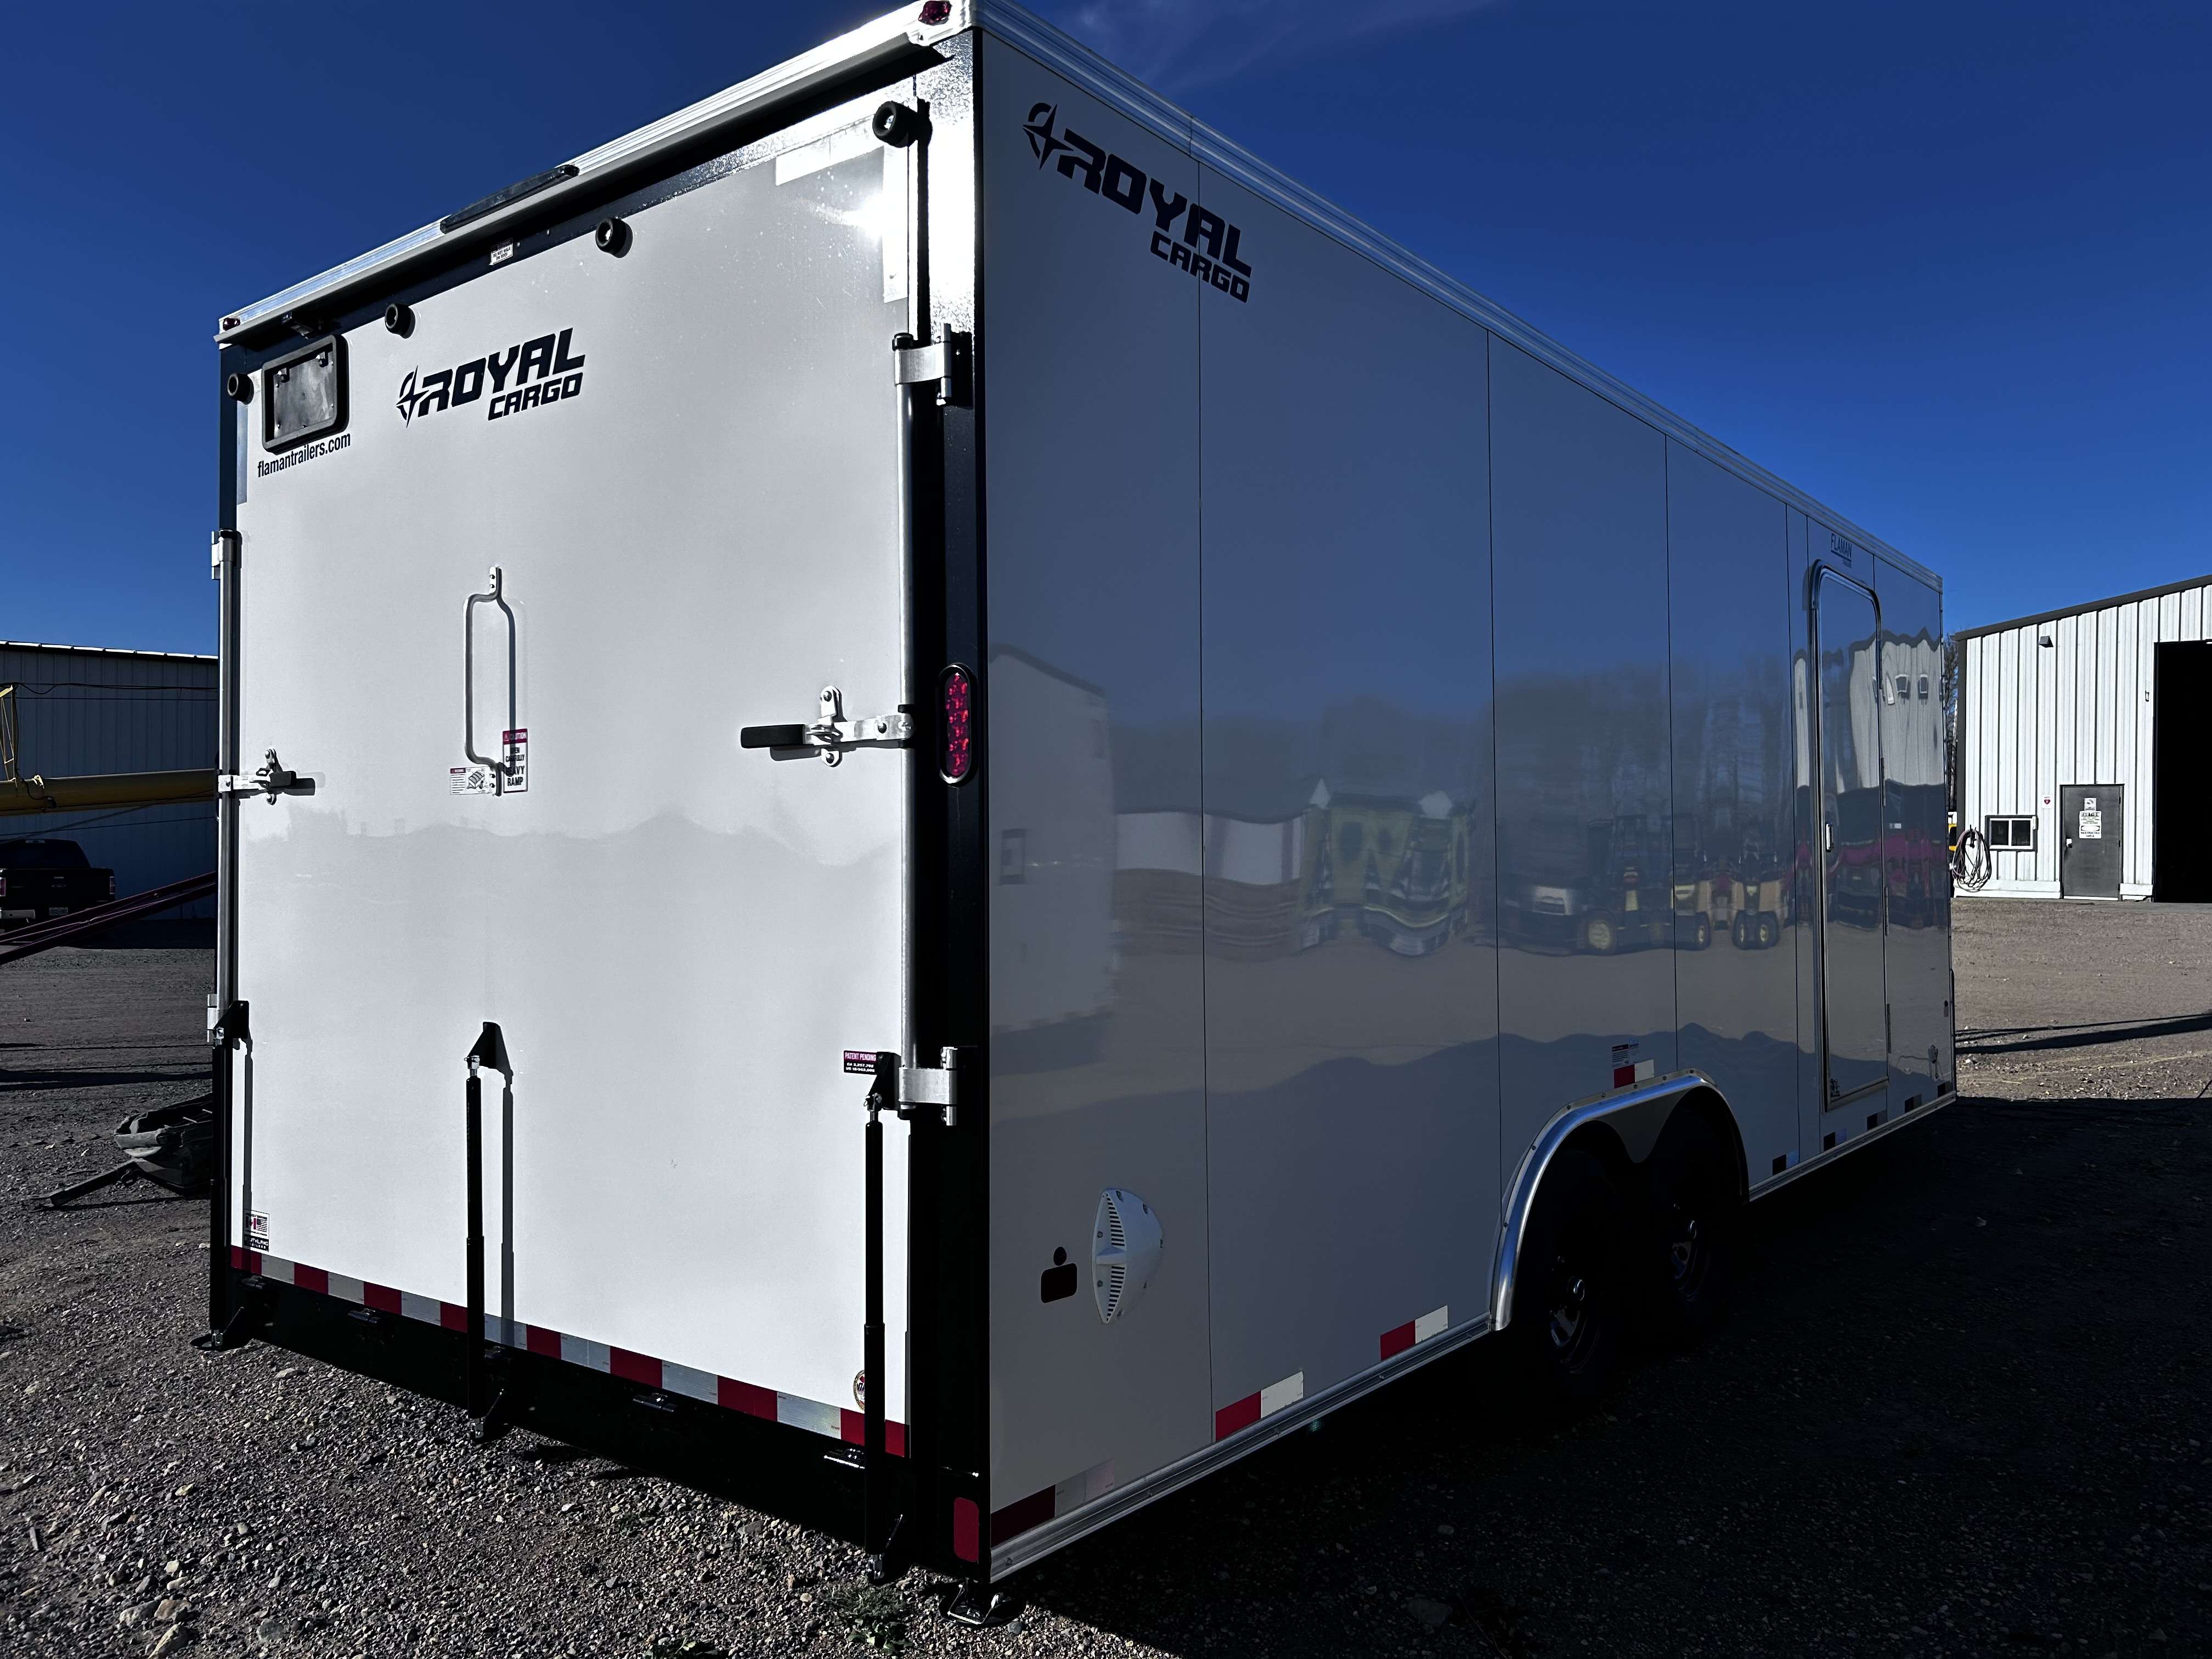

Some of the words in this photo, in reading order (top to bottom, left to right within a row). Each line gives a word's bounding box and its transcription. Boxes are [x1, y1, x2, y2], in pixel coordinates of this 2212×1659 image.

[1057, 127, 1252, 278] ROYAL
[1150, 230, 1250, 303] CARGO
[417, 327, 585, 417] ROYAL
[488, 372, 583, 421] CARGO
[257, 432, 351, 478] flamantrailers.com
[1831, 533, 1852, 558] FLAMAN
[507, 777, 524, 786] RAMP
